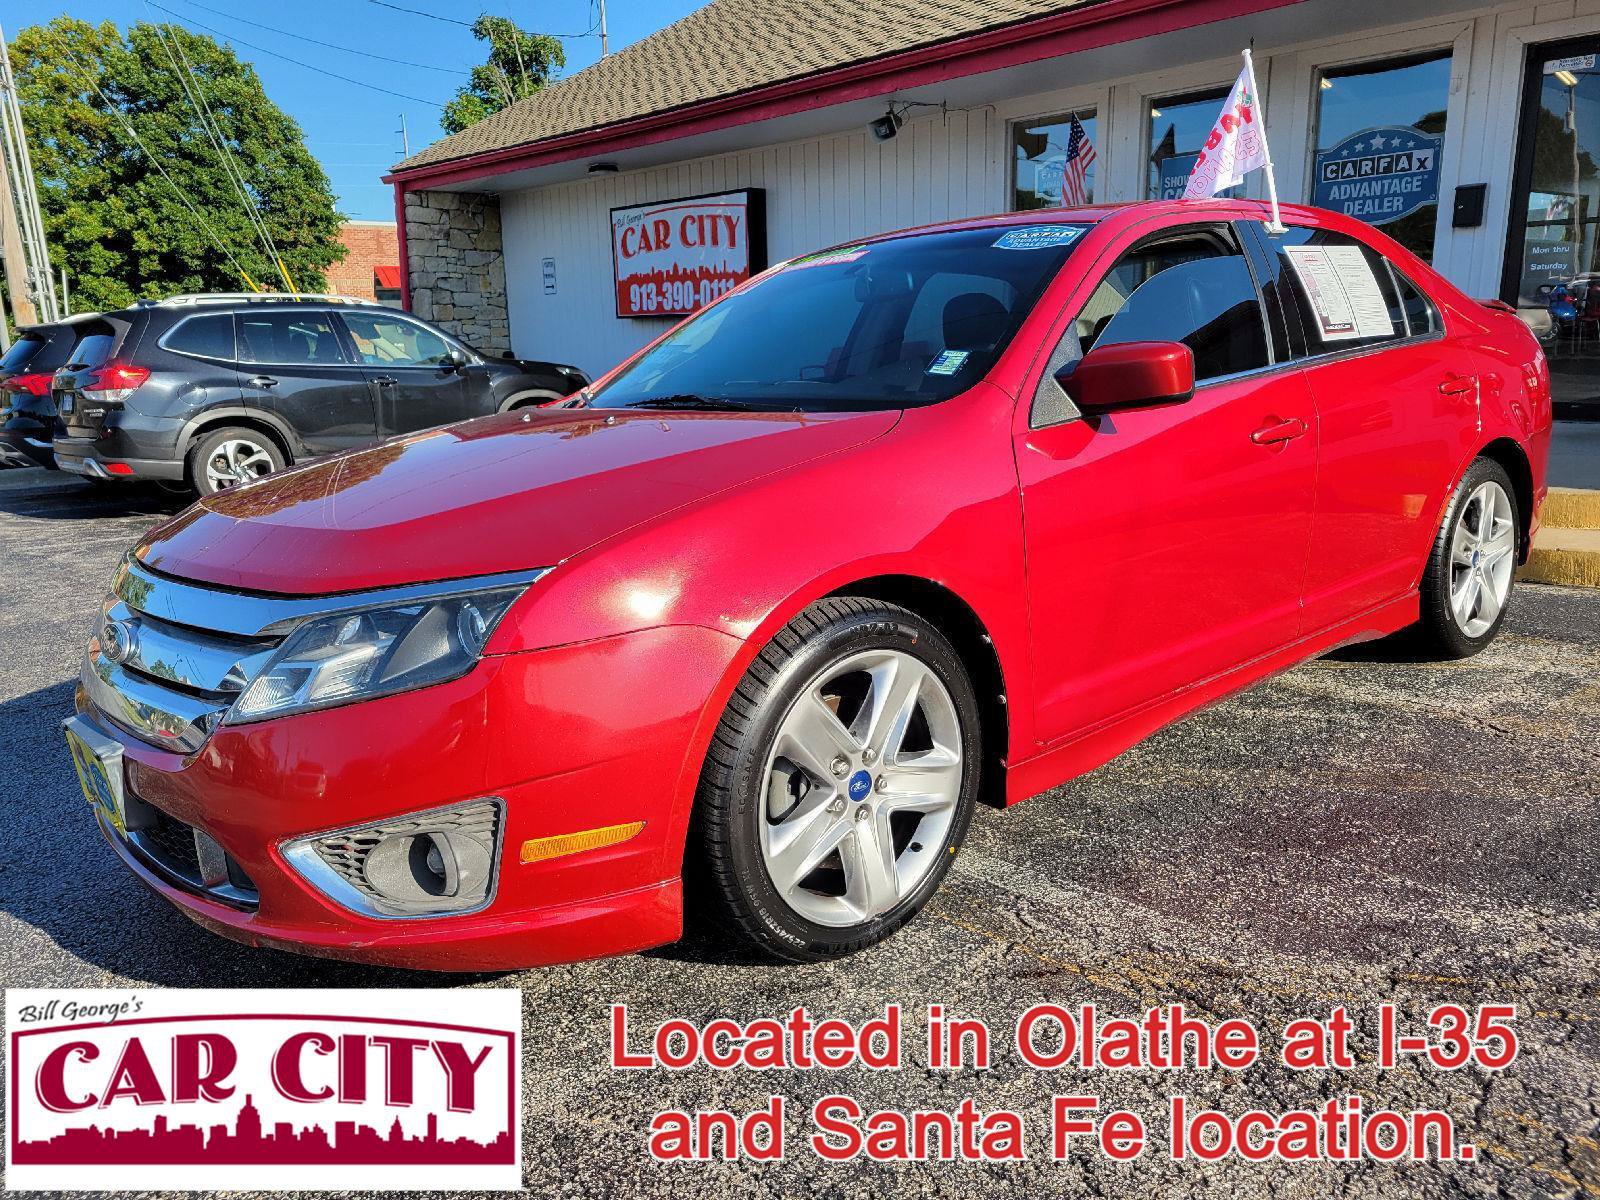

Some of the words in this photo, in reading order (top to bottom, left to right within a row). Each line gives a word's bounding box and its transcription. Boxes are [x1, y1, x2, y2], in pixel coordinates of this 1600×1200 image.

[1324, 153, 1431, 180] CARFAX
[1328, 176, 1423, 201] ADVANTAGE
[1343, 196, 1405, 216] DEALER
[620, 219, 672, 259] CAR
[679, 213, 741, 250] CITY
[1532, 246, 1550, 255] Mon
[1552, 245, 1570, 254] thru
[1530, 262, 1568, 271] Saturday
[759, 906, 806, 949] 225/45ZR18
